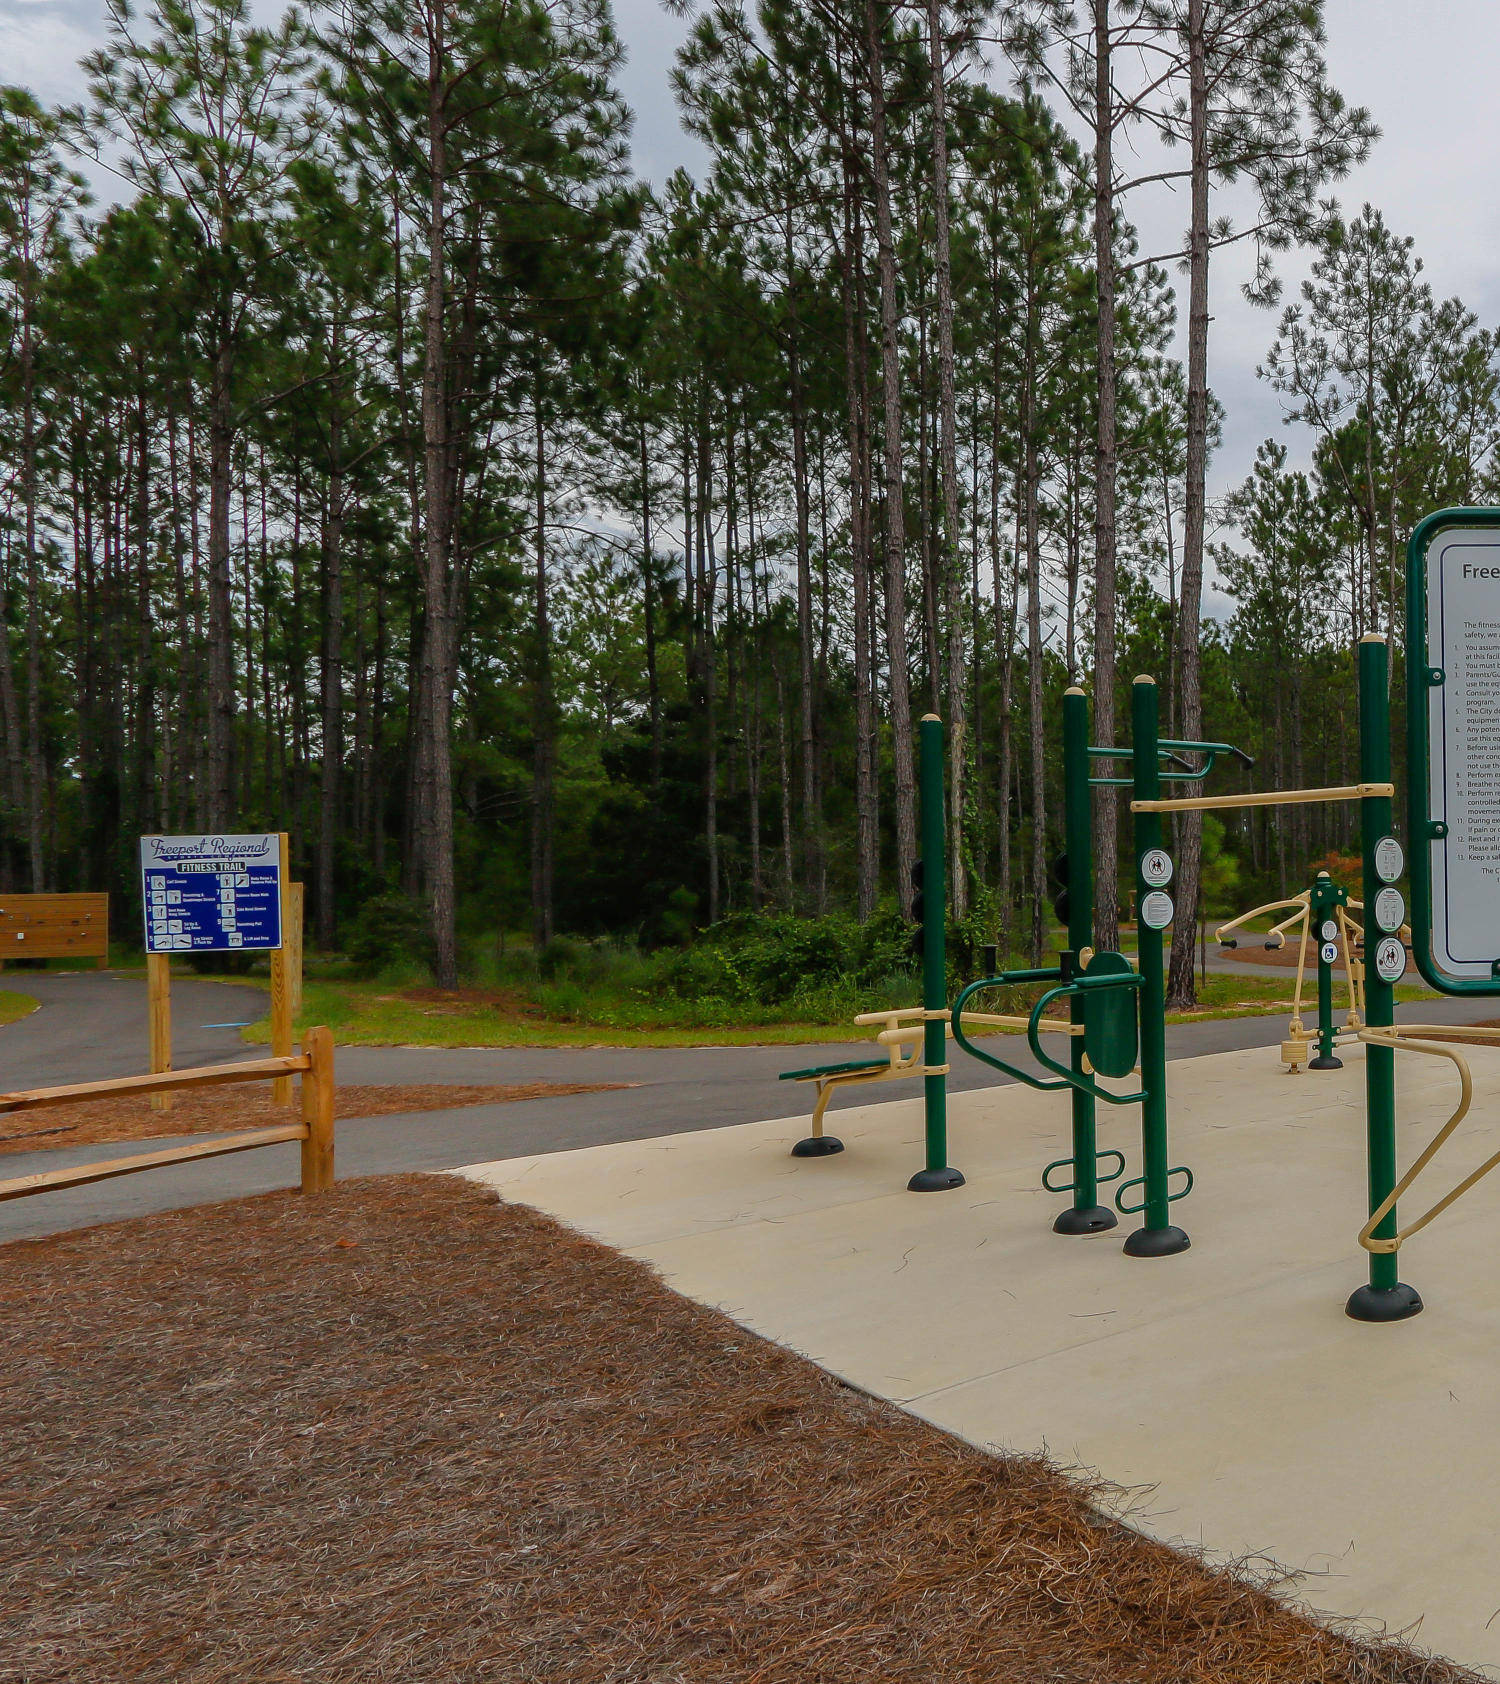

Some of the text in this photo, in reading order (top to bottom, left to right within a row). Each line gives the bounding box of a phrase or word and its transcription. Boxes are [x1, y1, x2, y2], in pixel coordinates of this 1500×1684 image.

[1479, 707, 1493, 715] City
[1466, 726, 1480, 734] Any
[1467, 817, 1491, 825] During
[1473, 826, 1488, 834] pain
[150, 836, 270, 861] Freeport Regional
[181, 862, 243, 872] FITNESS TRAIL
